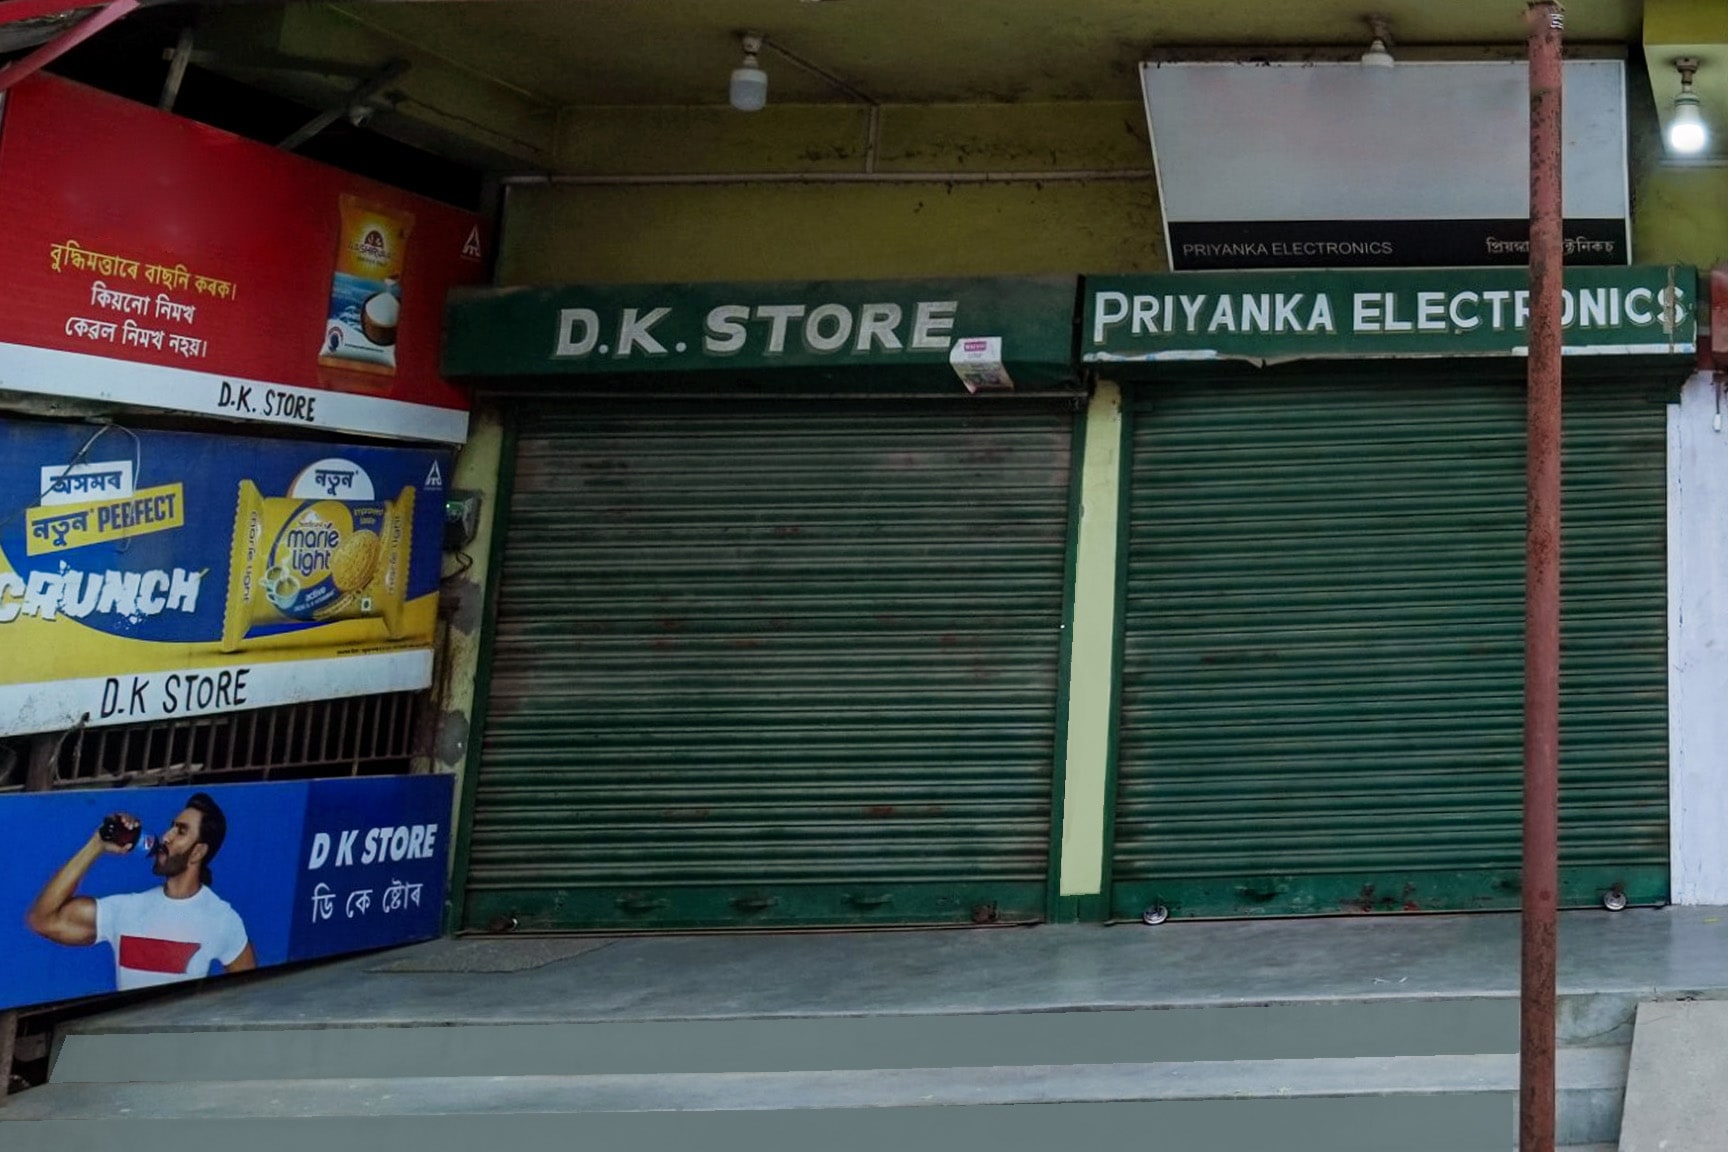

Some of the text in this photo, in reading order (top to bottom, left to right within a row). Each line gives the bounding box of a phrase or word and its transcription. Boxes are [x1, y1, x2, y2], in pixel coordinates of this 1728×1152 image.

[1183, 241, 1393, 256] PRIYANKA ELECTRONICS
[145, 264, 190, 291] বাছনি
[91, 281, 196, 324] কিয়নো নিমখ
[1094, 291, 1333, 343] PRIYANKA
[65, 317, 117, 342] কেৱল
[122, 319, 166, 350] নিমখ
[555, 300, 958, 356] D.K. STORE
[218, 381, 316, 422] D.K. STORE
[98, 493, 176, 532] PERFECT
[291, 550, 331, 576] light
[0, 567, 203, 624] CRUNCH
[101, 669, 250, 718] D.K STORE
[308, 824, 438, 870] D K STORE
[312, 882, 336, 923] ডি
[346, 889, 373, 918] কে
